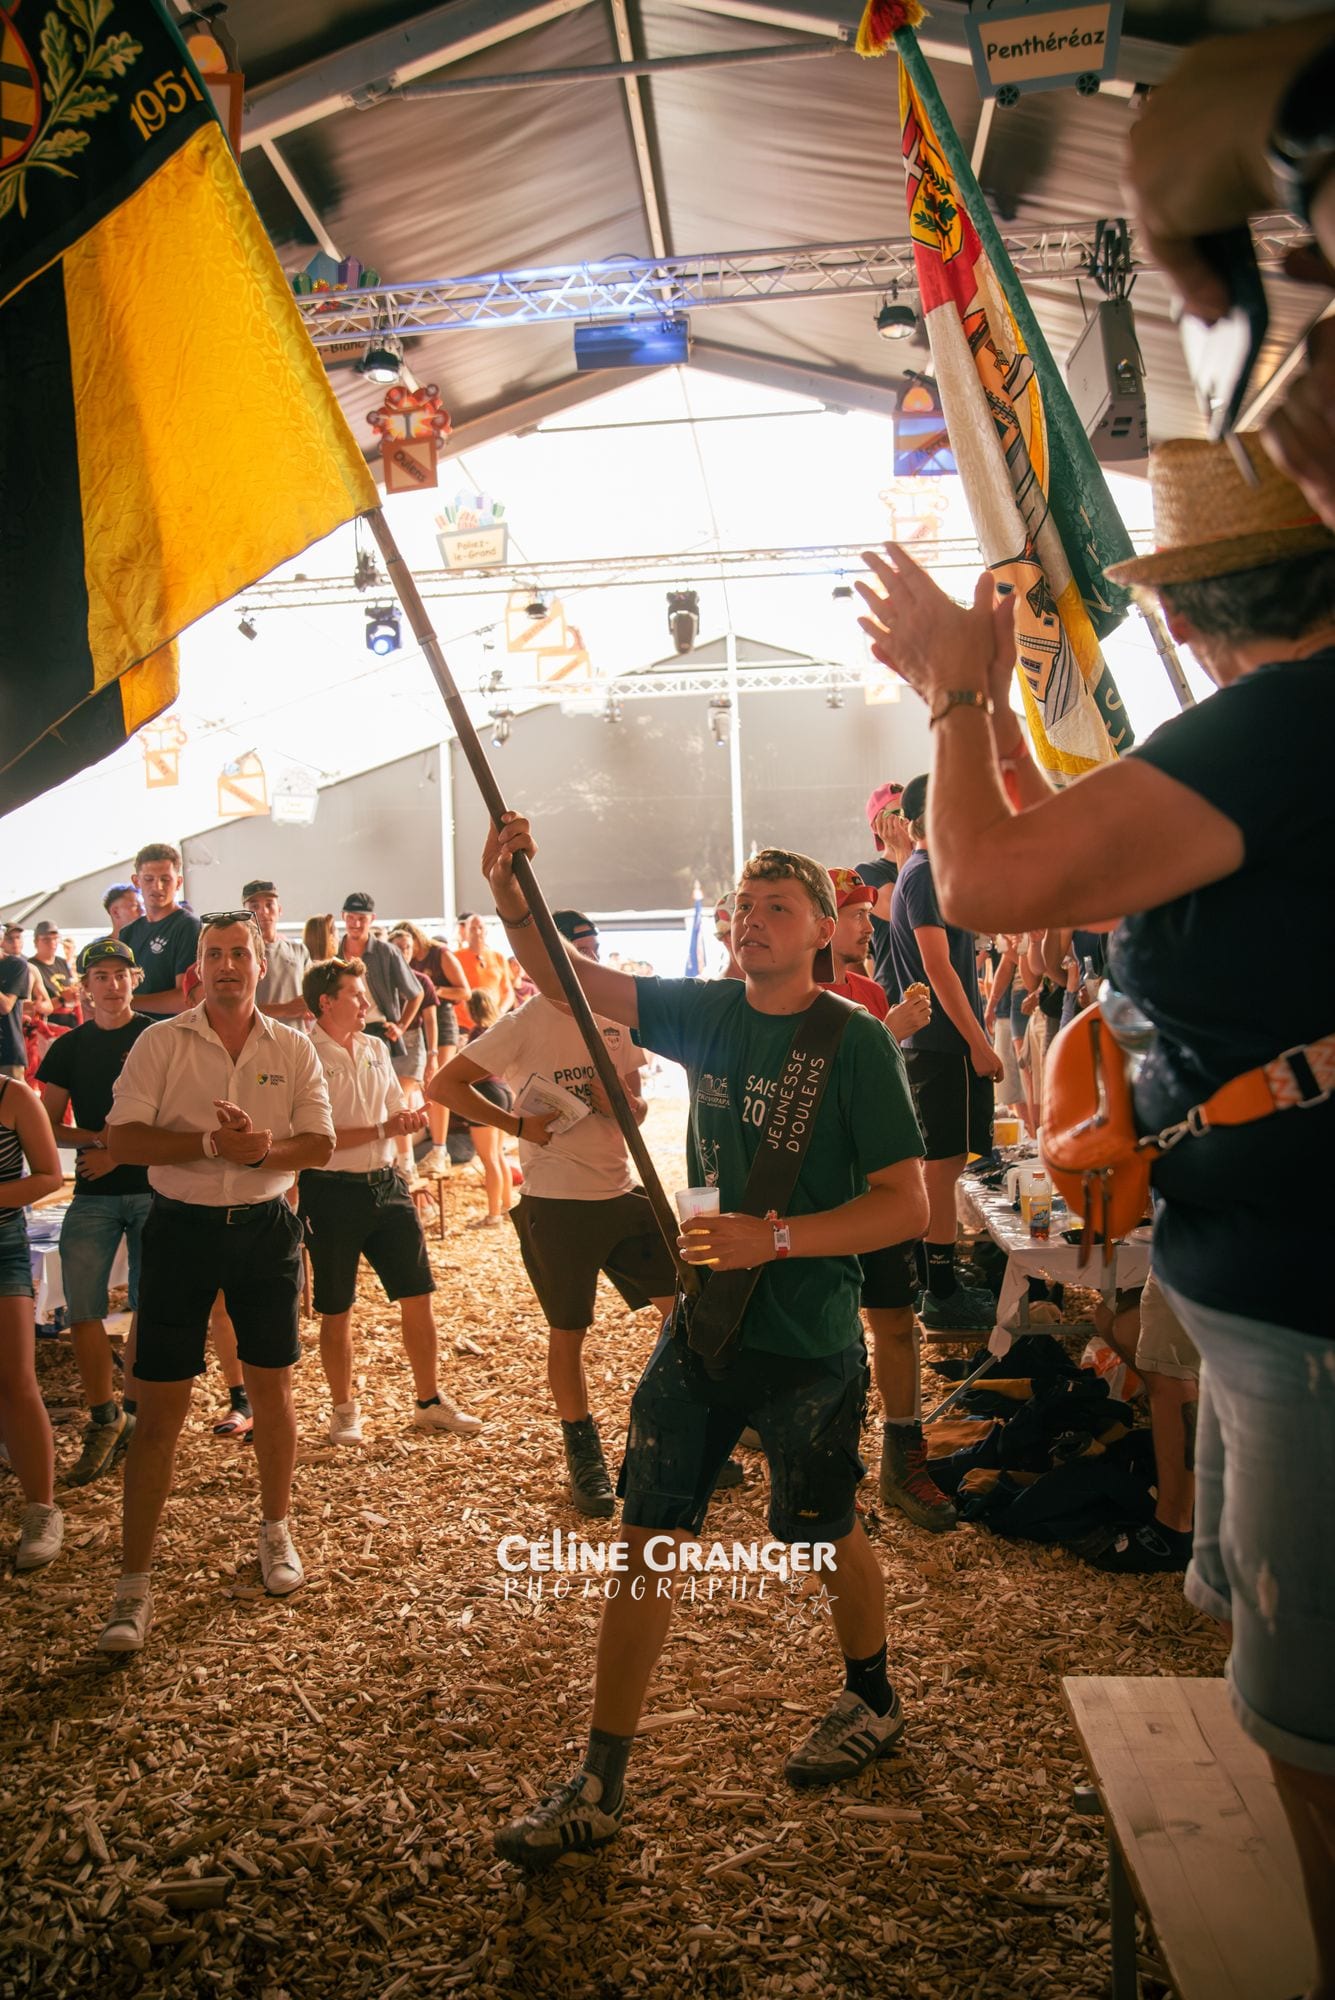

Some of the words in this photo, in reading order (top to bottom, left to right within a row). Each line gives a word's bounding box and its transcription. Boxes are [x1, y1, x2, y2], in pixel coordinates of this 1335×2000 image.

[987, 28, 1105, 61] Penthéréaz
[130, 66, 204, 141] 1951
[767, 1049, 806, 1150] JEUNESSE
[786, 1057, 825, 1152] D'OULENS
